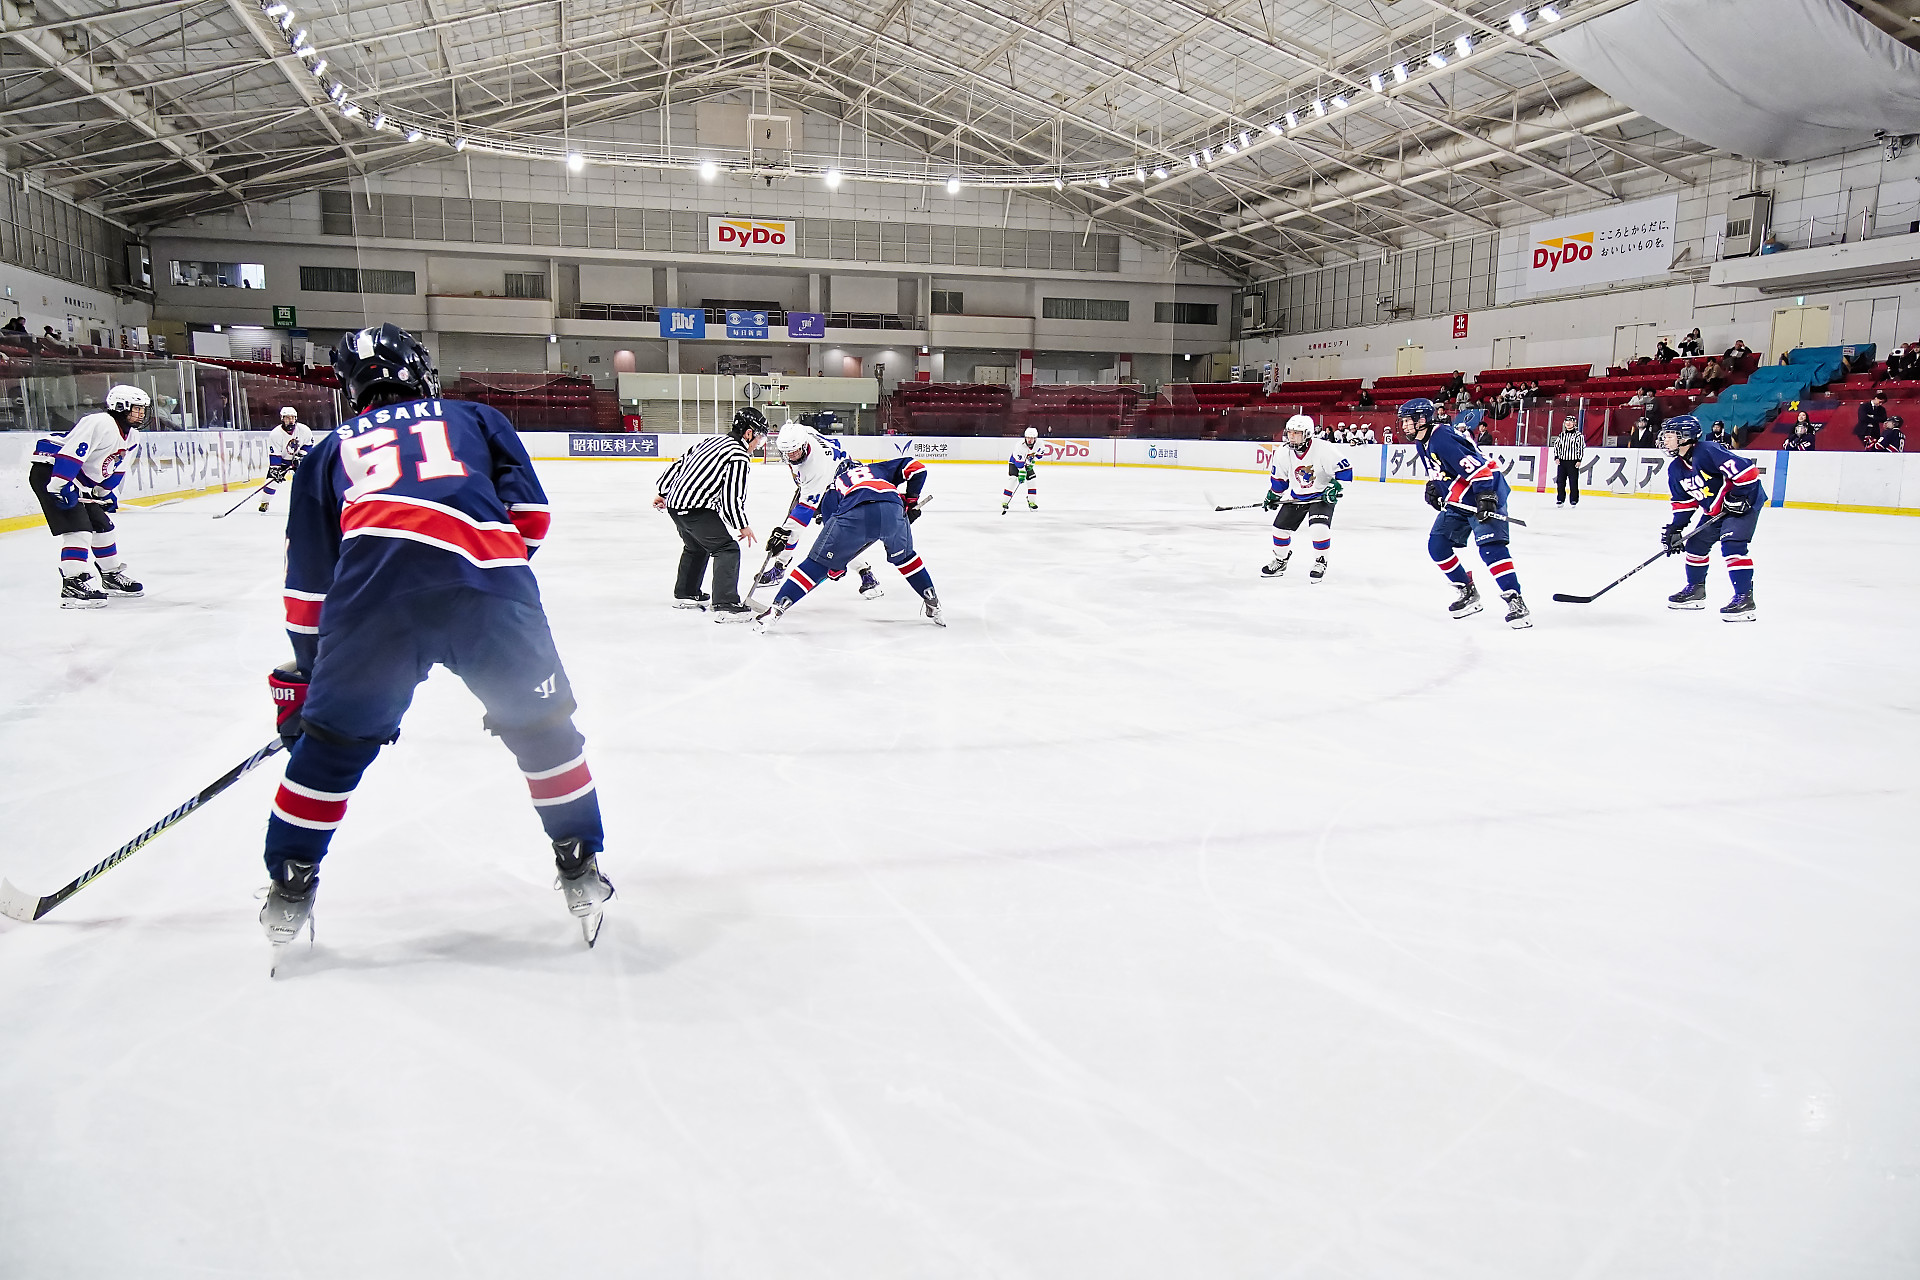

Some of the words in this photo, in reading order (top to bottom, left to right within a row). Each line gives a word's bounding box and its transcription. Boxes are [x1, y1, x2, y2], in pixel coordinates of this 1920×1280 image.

[718, 226, 786, 247] DyDo
[1599, 220, 1669, 241] こころとからだに、
[1533, 242, 1593, 272] DyDo
[1600, 237, 1665, 257] おいしいものを。
[278, 307, 290, 318] 西
[1456, 316, 1465, 329] 北
[336, 401, 443, 440] SASAKI
[76, 442, 88, 457] 8
[573, 439, 654, 452] 昭和医科大学
[914, 443, 948, 453] 明治大学
[1337, 459, 1350, 469] 10
[1459, 454, 1481, 474] 30
[1719, 459, 1739, 479] 17
